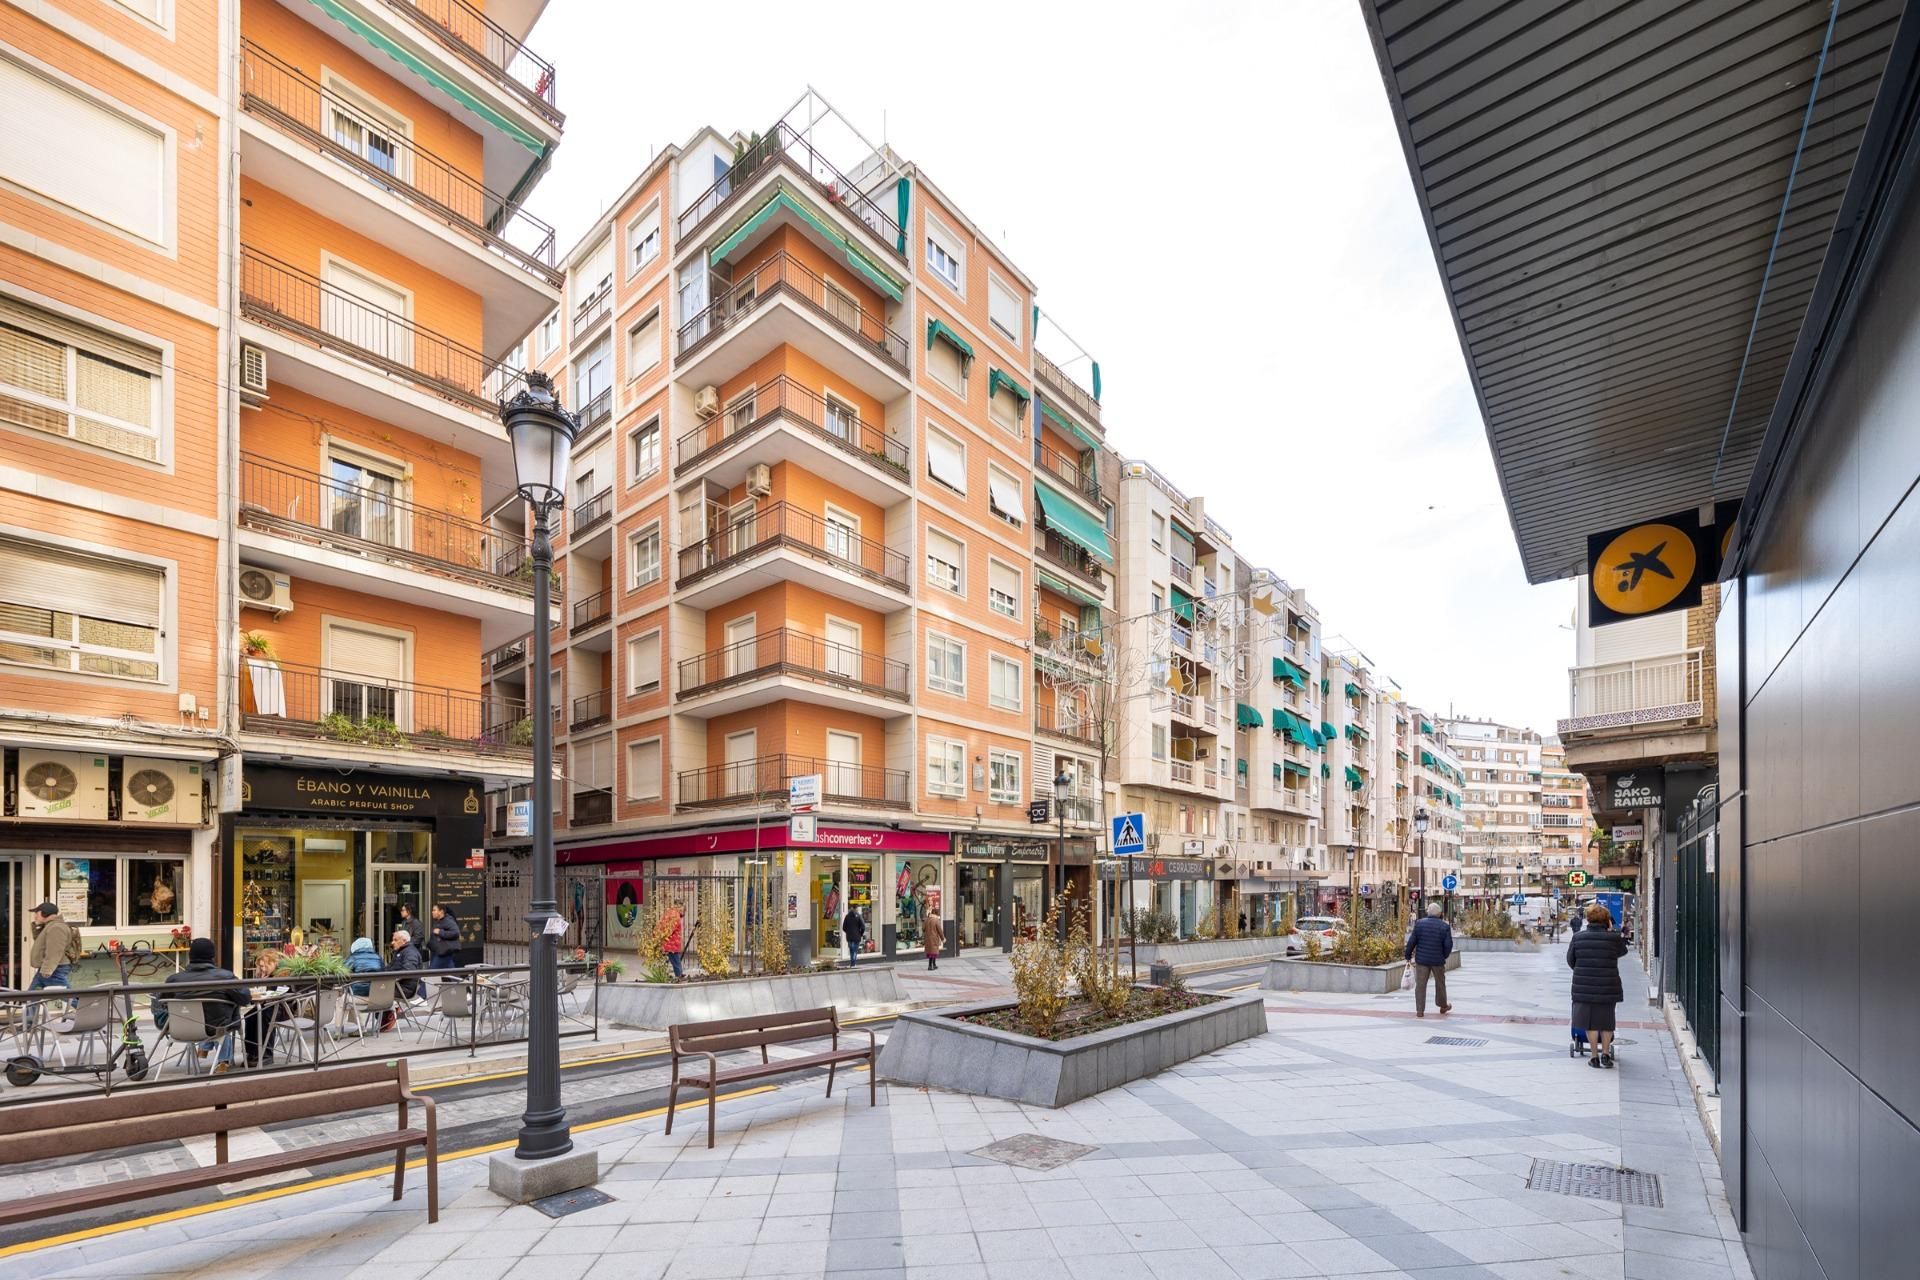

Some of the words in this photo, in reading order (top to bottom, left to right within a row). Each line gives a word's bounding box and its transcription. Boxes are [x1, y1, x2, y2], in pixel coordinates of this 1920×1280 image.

[296, 777, 351, 794] ÉBANO
[356, 783, 366, 795] Y
[369, 785, 431, 799] VAINILLA
[1614, 787, 1651, 798] JAKO
[310, 798, 347, 808] ARABIC
[349, 800, 387, 810] PERFUME
[390, 802, 415, 811] SHOP
[1614, 796, 1662, 807] RAMEN
[816, 832, 872, 845] ashconverters
